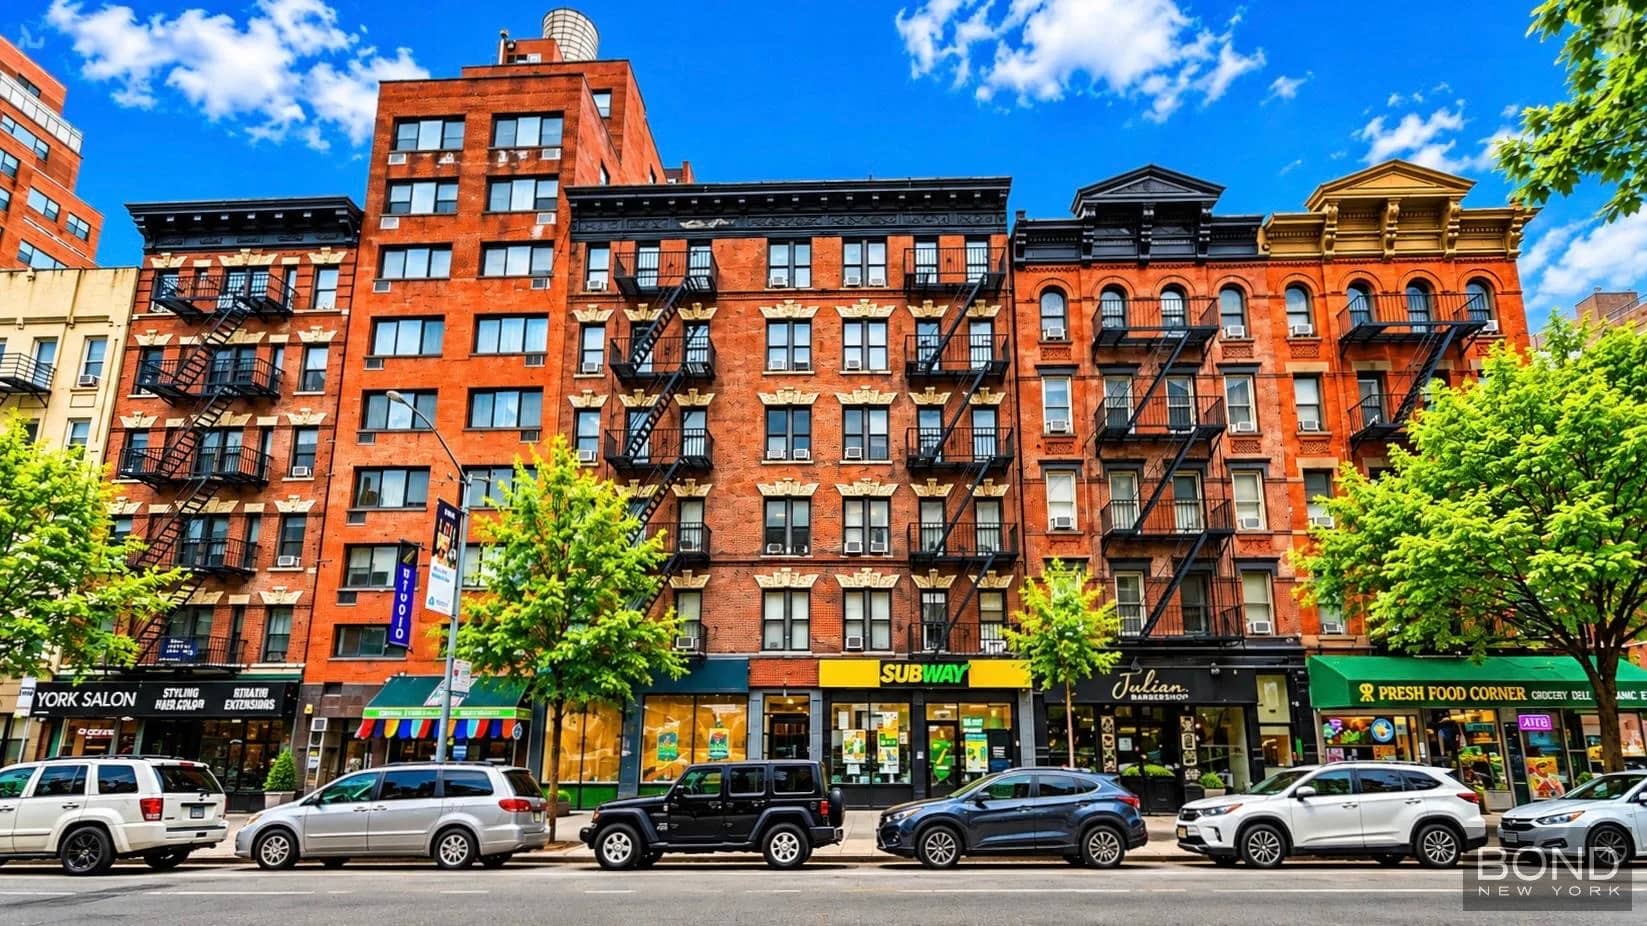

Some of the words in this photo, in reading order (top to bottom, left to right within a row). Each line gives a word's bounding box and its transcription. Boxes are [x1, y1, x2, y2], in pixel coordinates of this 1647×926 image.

[880, 663, 972, 684] SUBWAY
[37, 691, 80, 707] YORK
[81, 691, 137, 707] SALON
[163, 687, 200, 699] STYLING
[1130, 693, 1189, 701] BARBERSHOP
[1428, 686, 1467, 701] FOOD
[1470, 686, 1528, 701] CORNER
